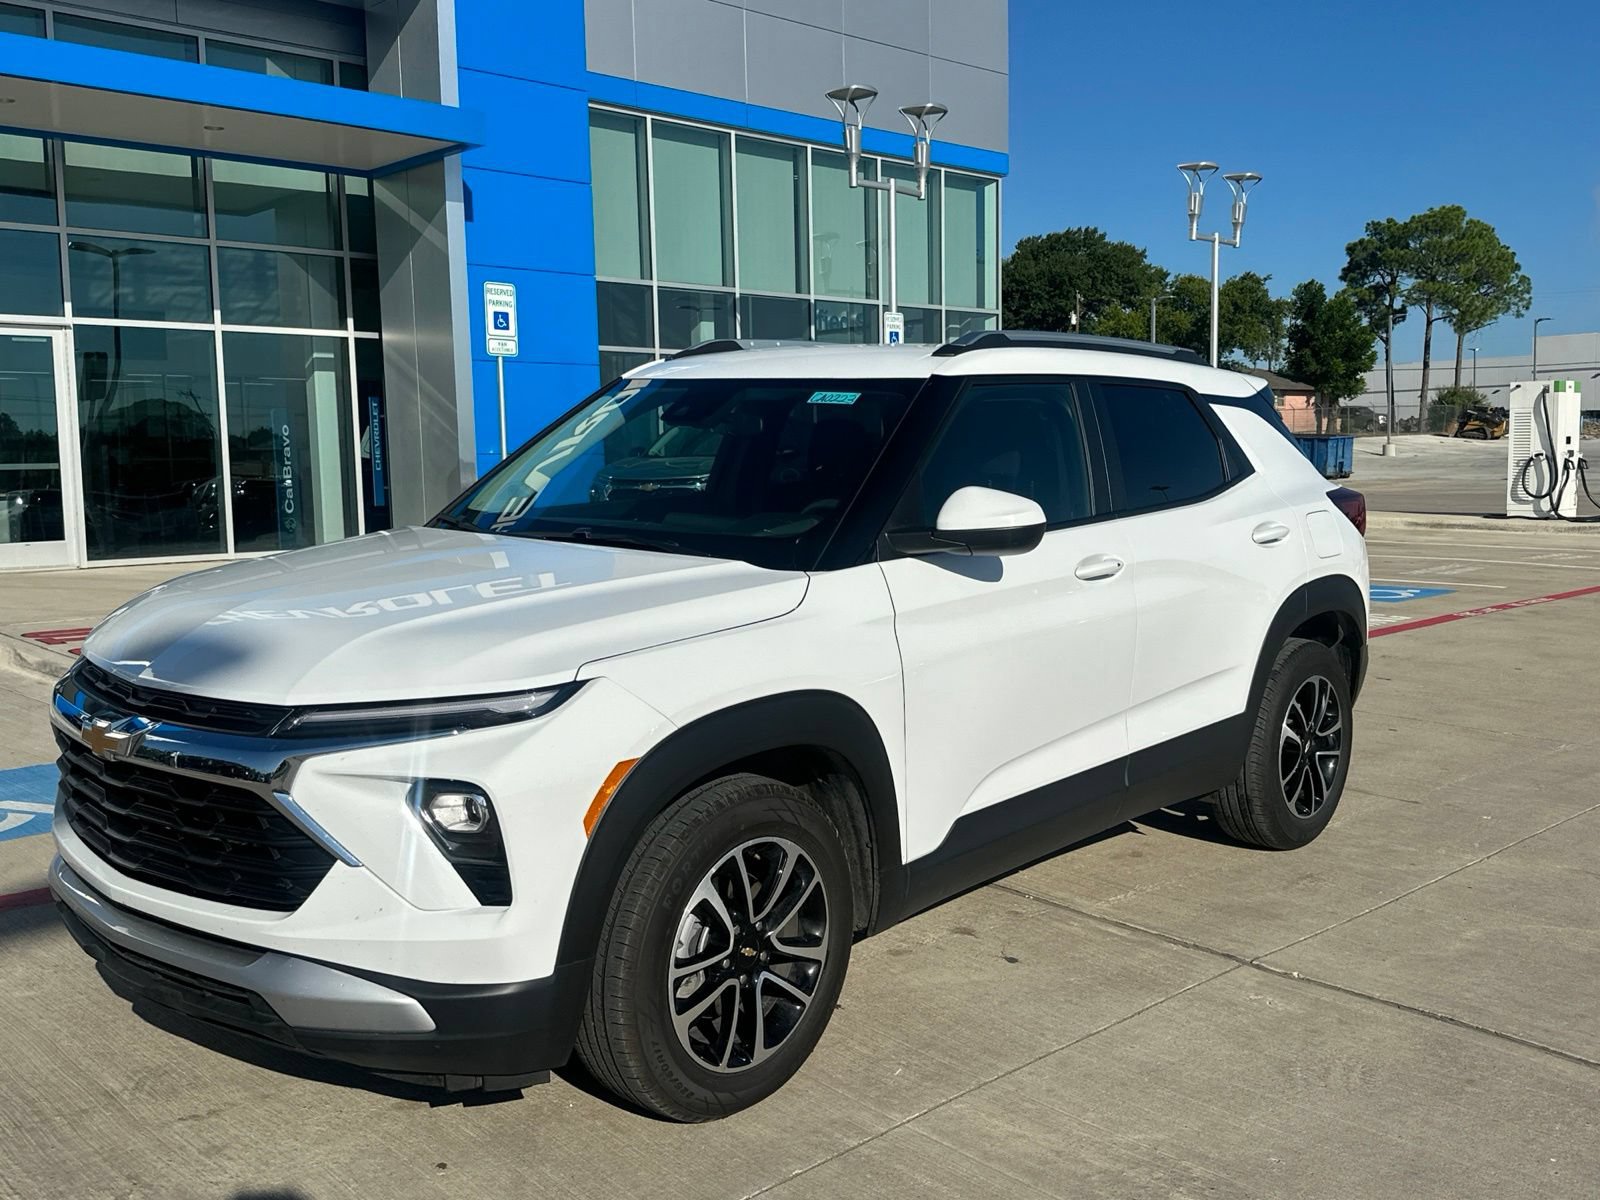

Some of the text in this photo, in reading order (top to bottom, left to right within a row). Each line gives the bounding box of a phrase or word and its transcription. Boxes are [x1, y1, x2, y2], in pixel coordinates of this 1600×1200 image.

[486, 287, 513, 297] RESERVED
[488, 299, 513, 308] PARKING
[371, 402, 382, 471] CHEVROLET
